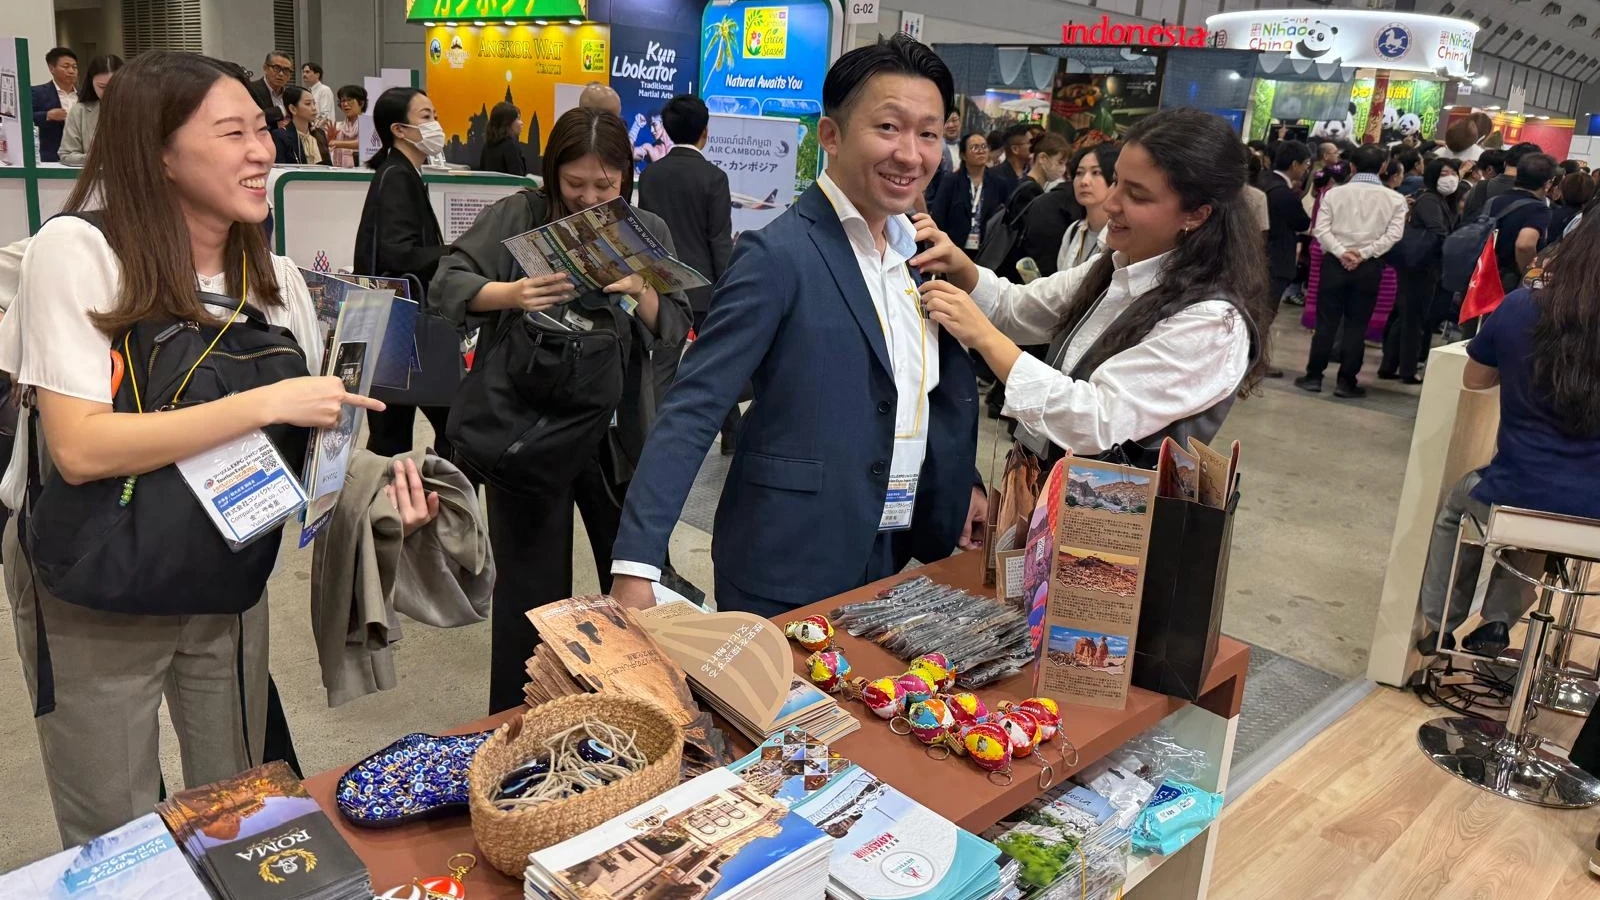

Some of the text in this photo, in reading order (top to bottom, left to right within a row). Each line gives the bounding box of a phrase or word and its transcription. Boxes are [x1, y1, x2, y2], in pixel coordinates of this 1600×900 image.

[853, 3, 873, 14] G-02
[764, 28, 784, 44] Green
[1062, 15, 1209, 47] indonesia
[1262, 22, 1308, 36] Nihao
[761, 47, 785, 57] Season
[1249, 38, 1293, 50] China
[646, 41, 676, 64] Kun
[1437, 46, 1464, 61] China
[611, 55, 678, 82] Lbokator
[640, 81, 674, 91] Traditional
[725, 74, 804, 90] Natural Awaits You
[638, 89, 660, 99] Martial
[708, 145, 771, 157] AIR CAMBODIA
[712, 160, 778, 173] ア・カンボジア
[230, 506, 255, 523] Compact
[701, 623, 750, 672] 文化に触れる
[708, 622, 765, 678] 歴史を探求する
[235, 829, 312, 861] ROMA
[91, 838, 164, 874] ランドへようこそ
